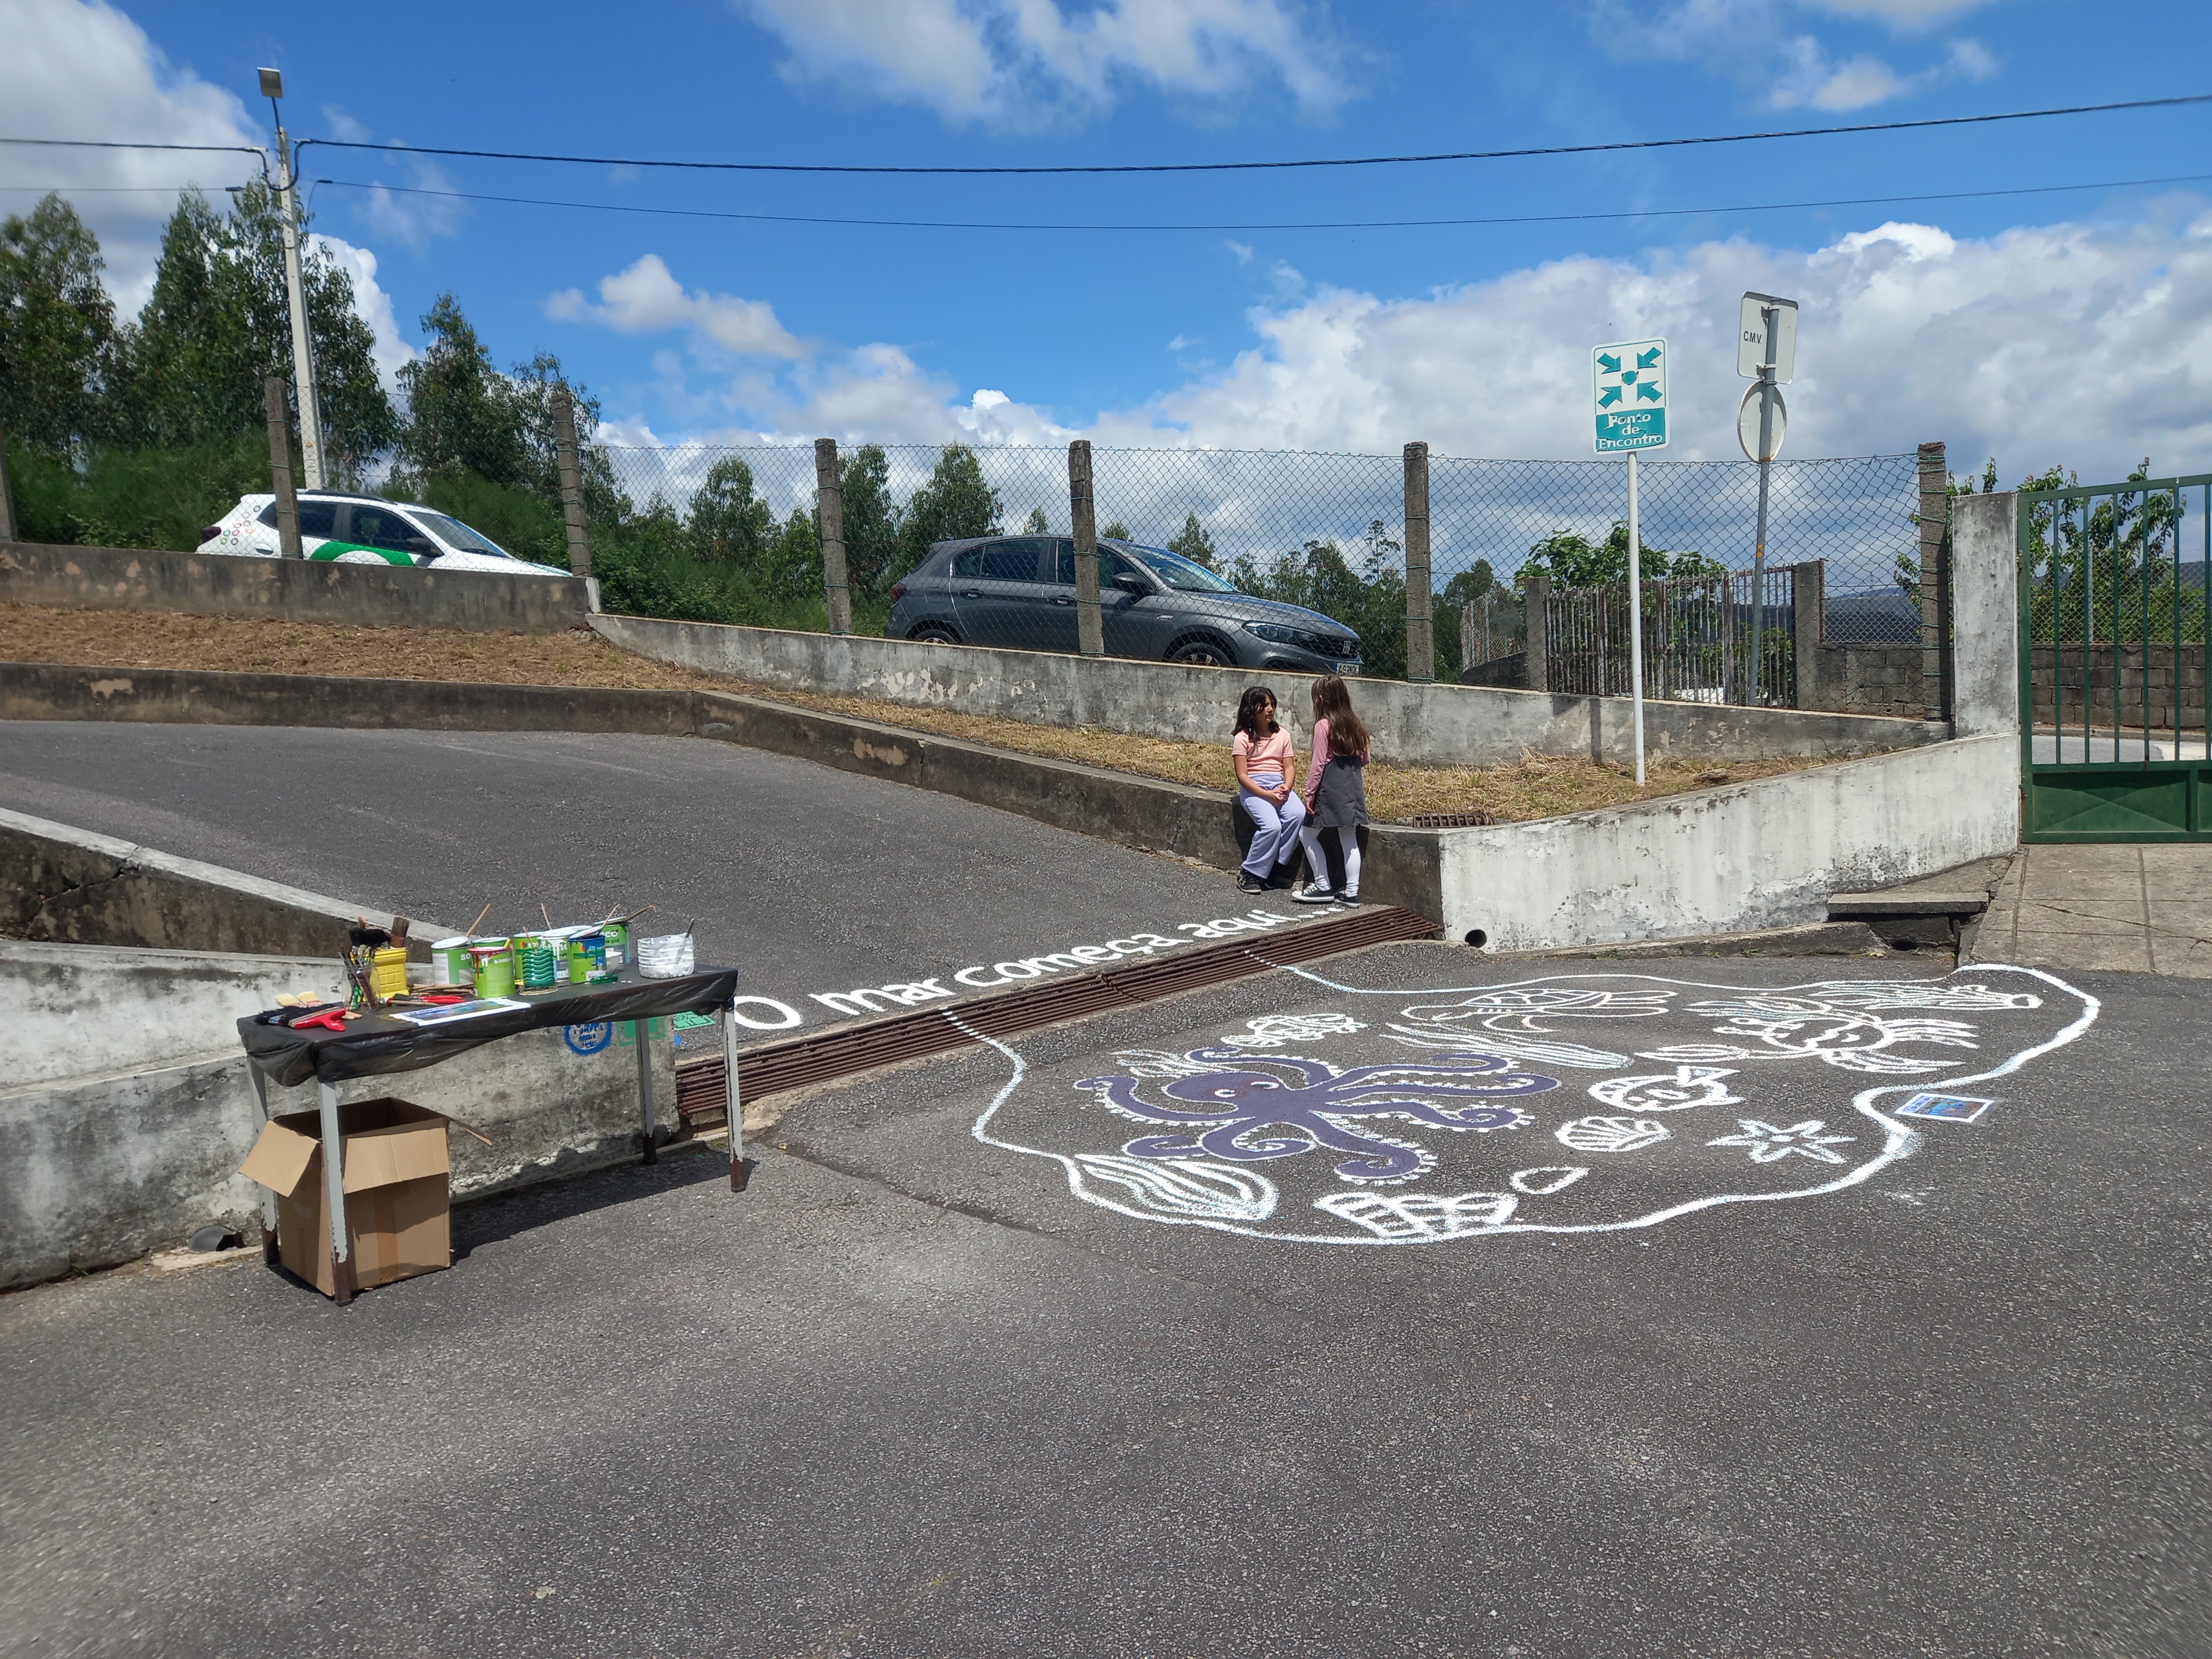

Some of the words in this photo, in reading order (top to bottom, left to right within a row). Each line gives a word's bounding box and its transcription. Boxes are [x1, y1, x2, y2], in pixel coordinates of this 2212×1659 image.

[1609, 414, 1651, 429] Ponto
[1622, 426, 1640, 435] de
[1599, 433, 1663, 449] Encontro
[733, 995, 801, 1030] O
[808, 978, 957, 1015] mar
[954, 933, 1193, 988] começa
